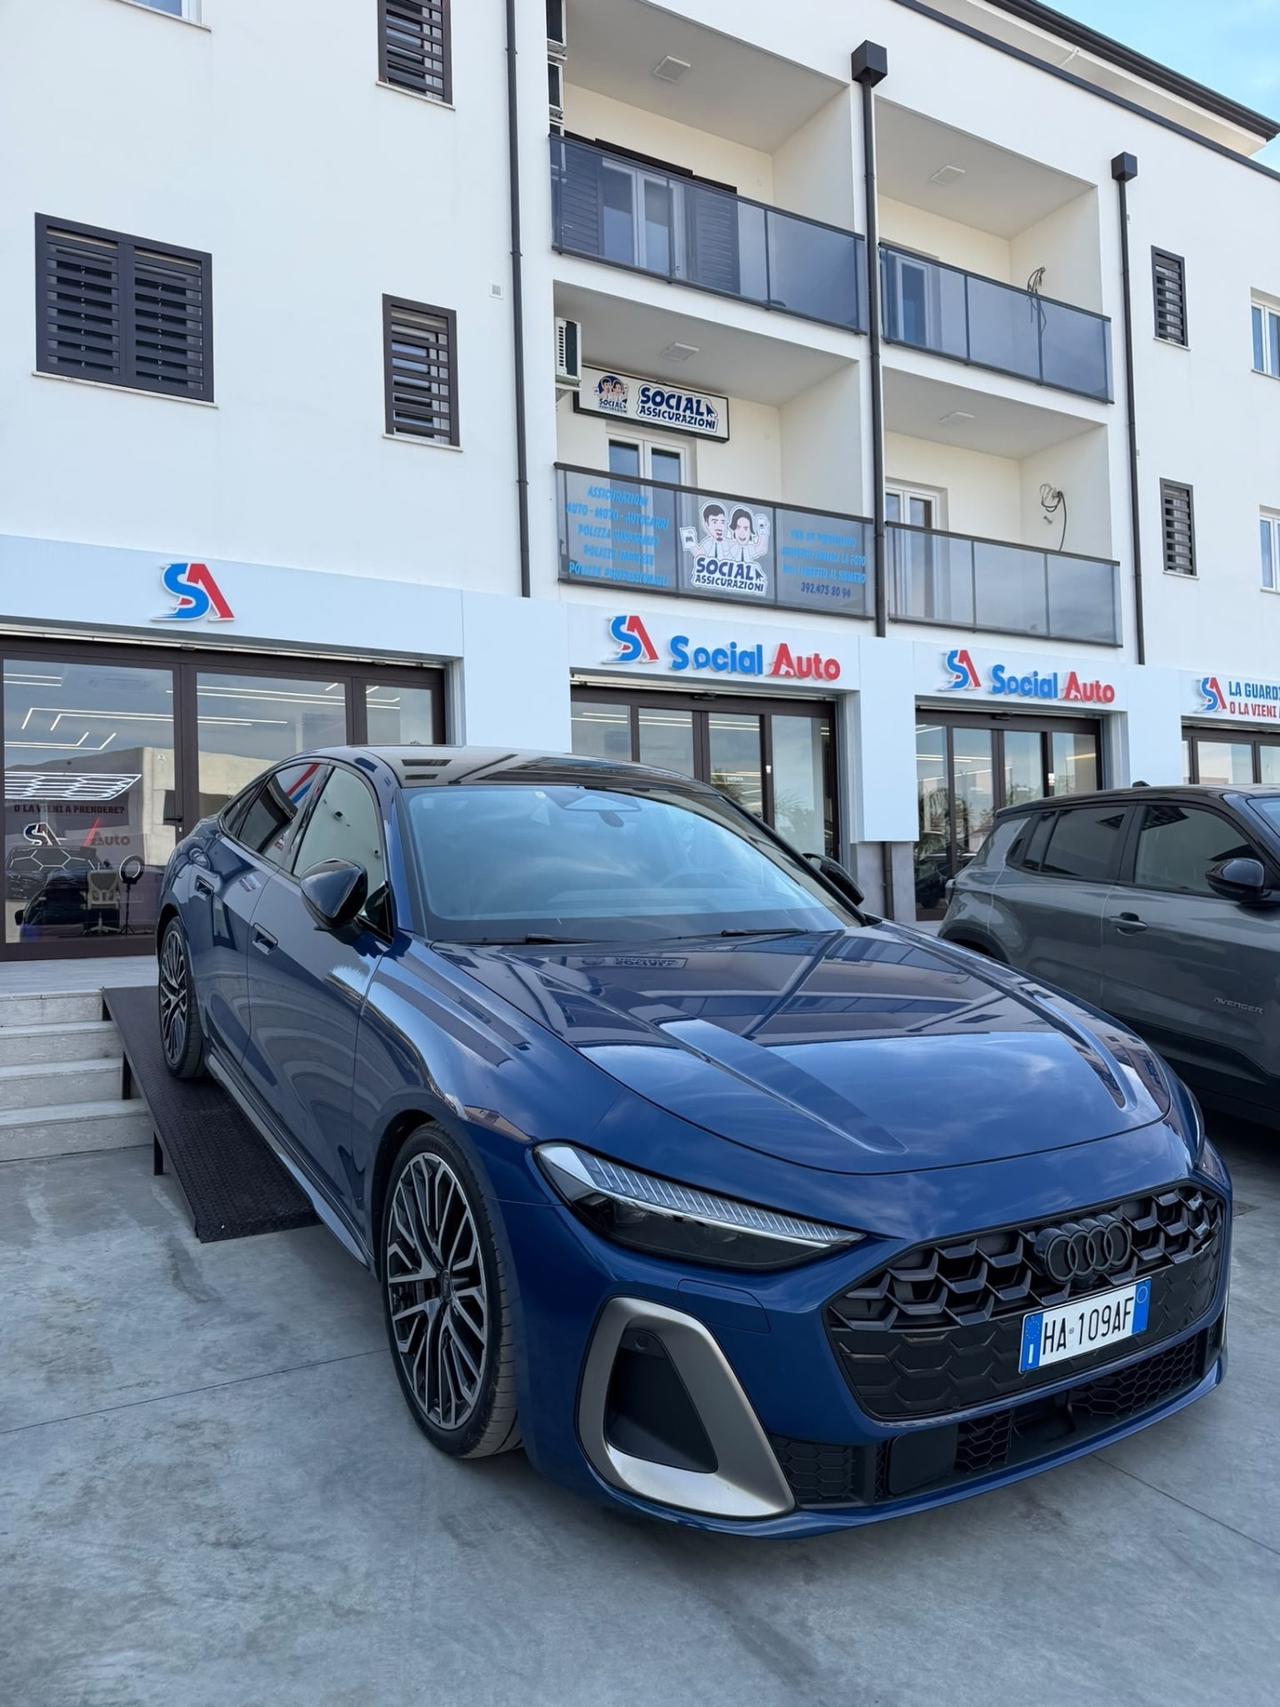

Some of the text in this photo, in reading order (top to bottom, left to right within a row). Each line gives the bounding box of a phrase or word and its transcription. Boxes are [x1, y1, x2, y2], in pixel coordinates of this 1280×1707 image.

[640, 386, 704, 417] SOCIAL
[639, 405, 716, 430] ASSICURAZIONI
[696, 557, 754, 581] SOCIAL
[695, 574, 764, 592] ASSICURAZIONI
[669, 635, 763, 675] Social
[768, 643, 841, 681] Auto
[991, 664, 1058, 700] Social
[1063, 671, 1115, 704] Auto
[1229, 681, 1242, 697] LA
[1238, 702, 1249, 716] LA
[1251, 703, 1277, 718] VIENI
[1042, 1317, 1067, 1355] HA
[1078, 1296, 1134, 1346] 109AF
